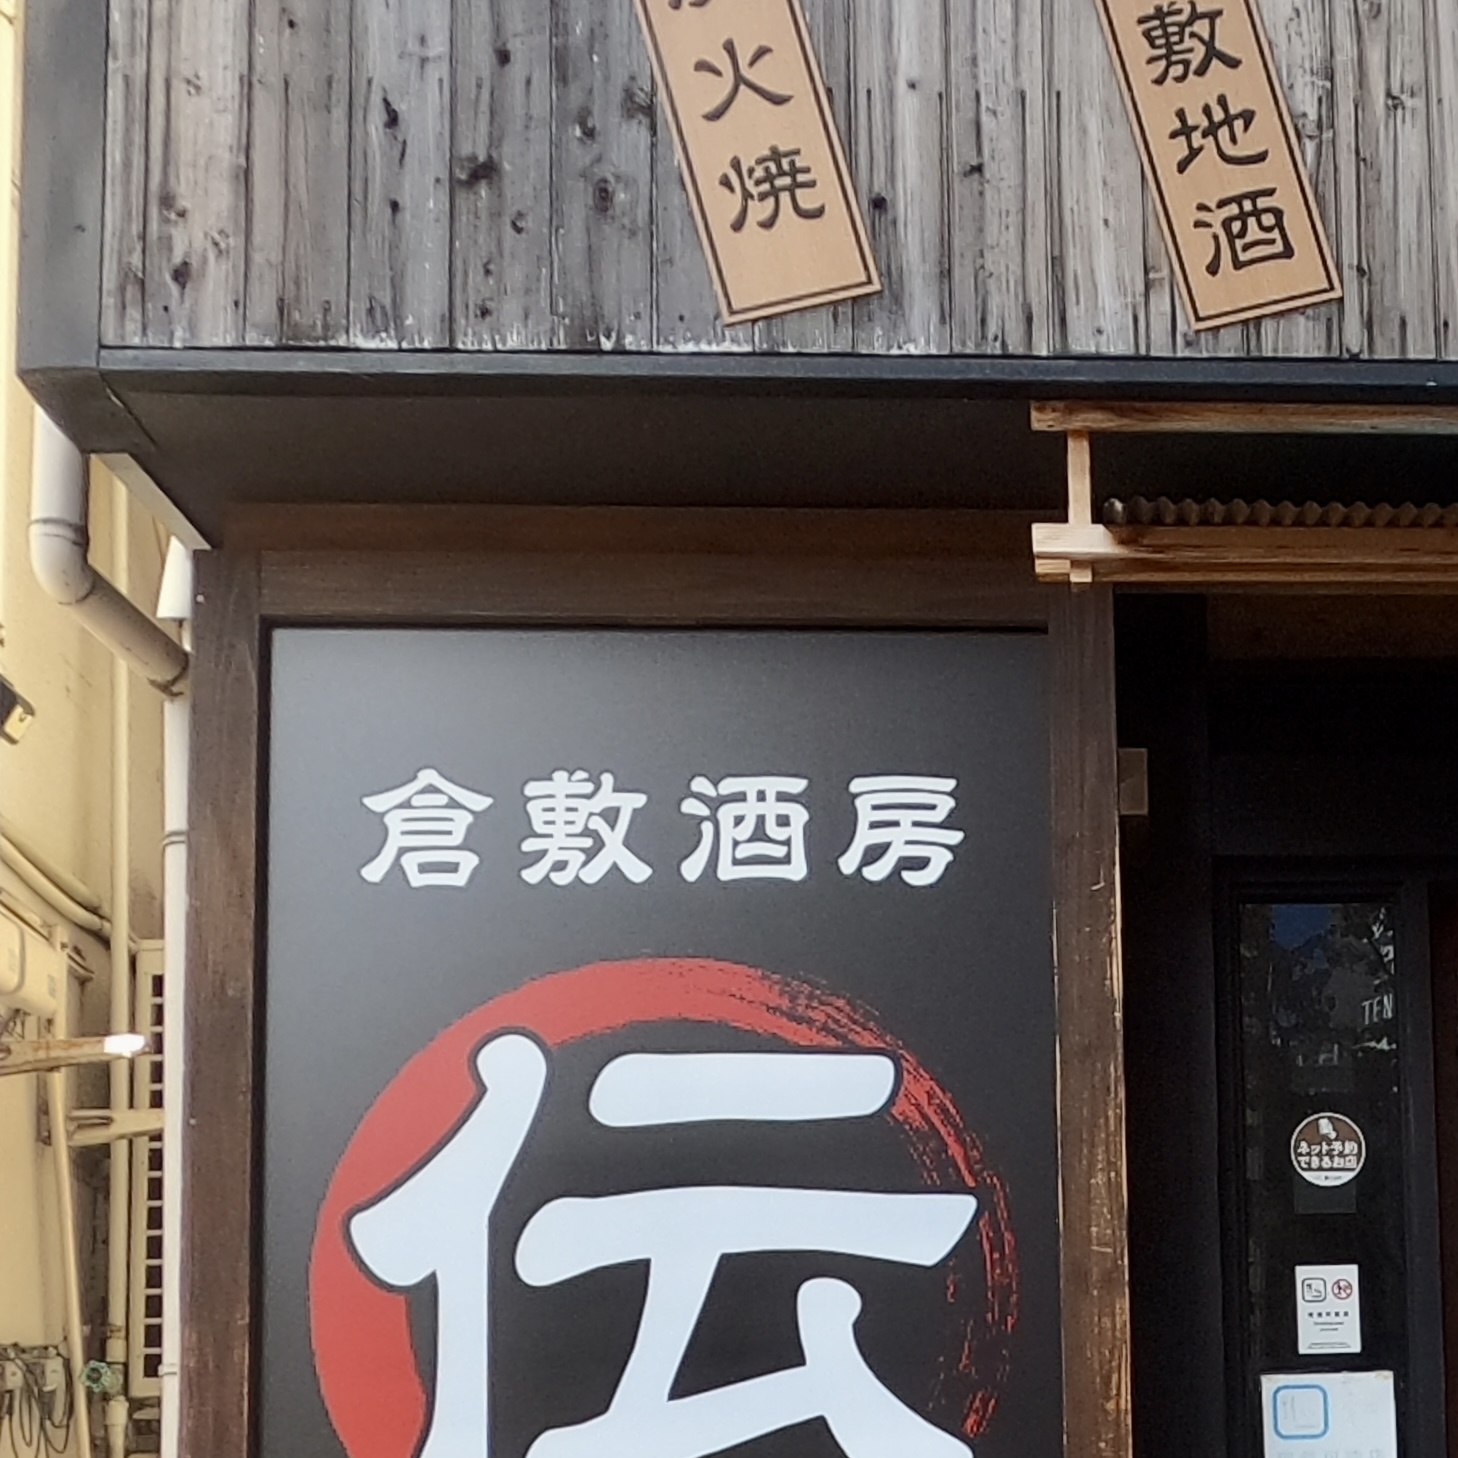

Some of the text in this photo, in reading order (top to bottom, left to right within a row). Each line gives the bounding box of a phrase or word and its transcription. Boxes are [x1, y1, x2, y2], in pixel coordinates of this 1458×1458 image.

[667, 0, 827, 232] 火焼
[1137, 0, 1296, 277] 敷地酒
[360, 768, 965, 888] 倉敷酒房
